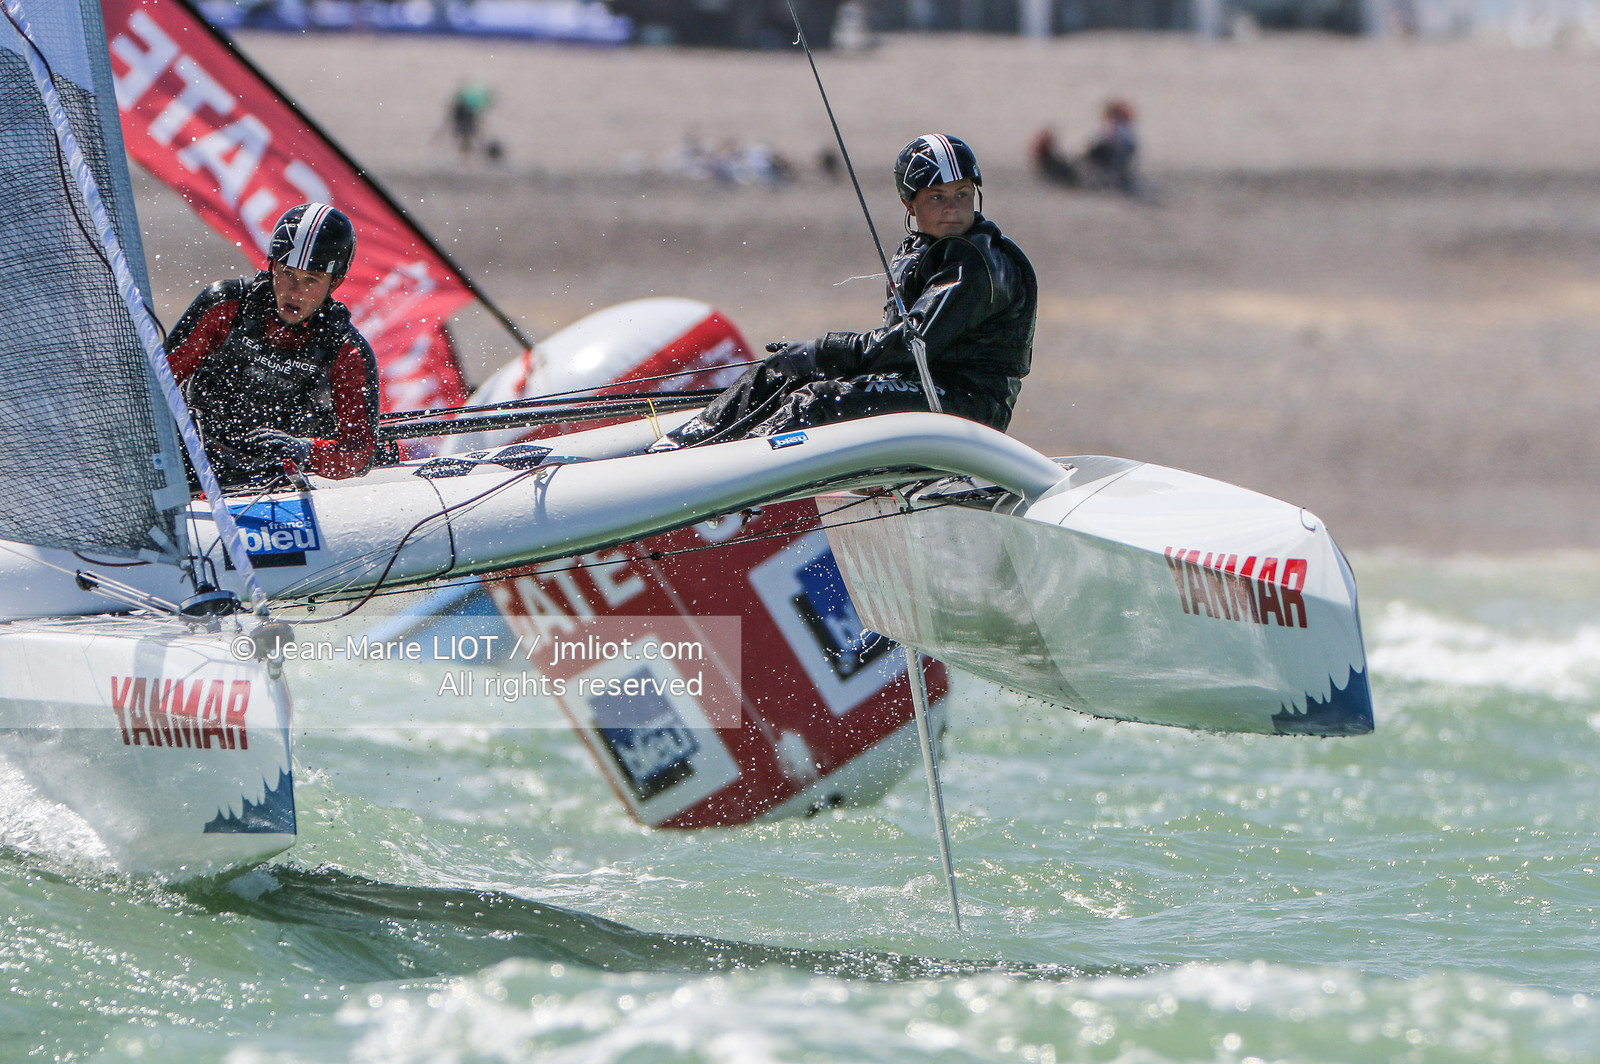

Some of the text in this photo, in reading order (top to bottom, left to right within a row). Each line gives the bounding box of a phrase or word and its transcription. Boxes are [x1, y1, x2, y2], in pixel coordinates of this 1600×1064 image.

[241, 336, 317, 373] TEA FANCE
[254, 355, 292, 375] JEUNE
[238, 526, 316, 552] bleu
[268, 520, 312, 530] france
[1164, 546, 1307, 628] YANMAR
[111, 676, 251, 750] YANMAR
